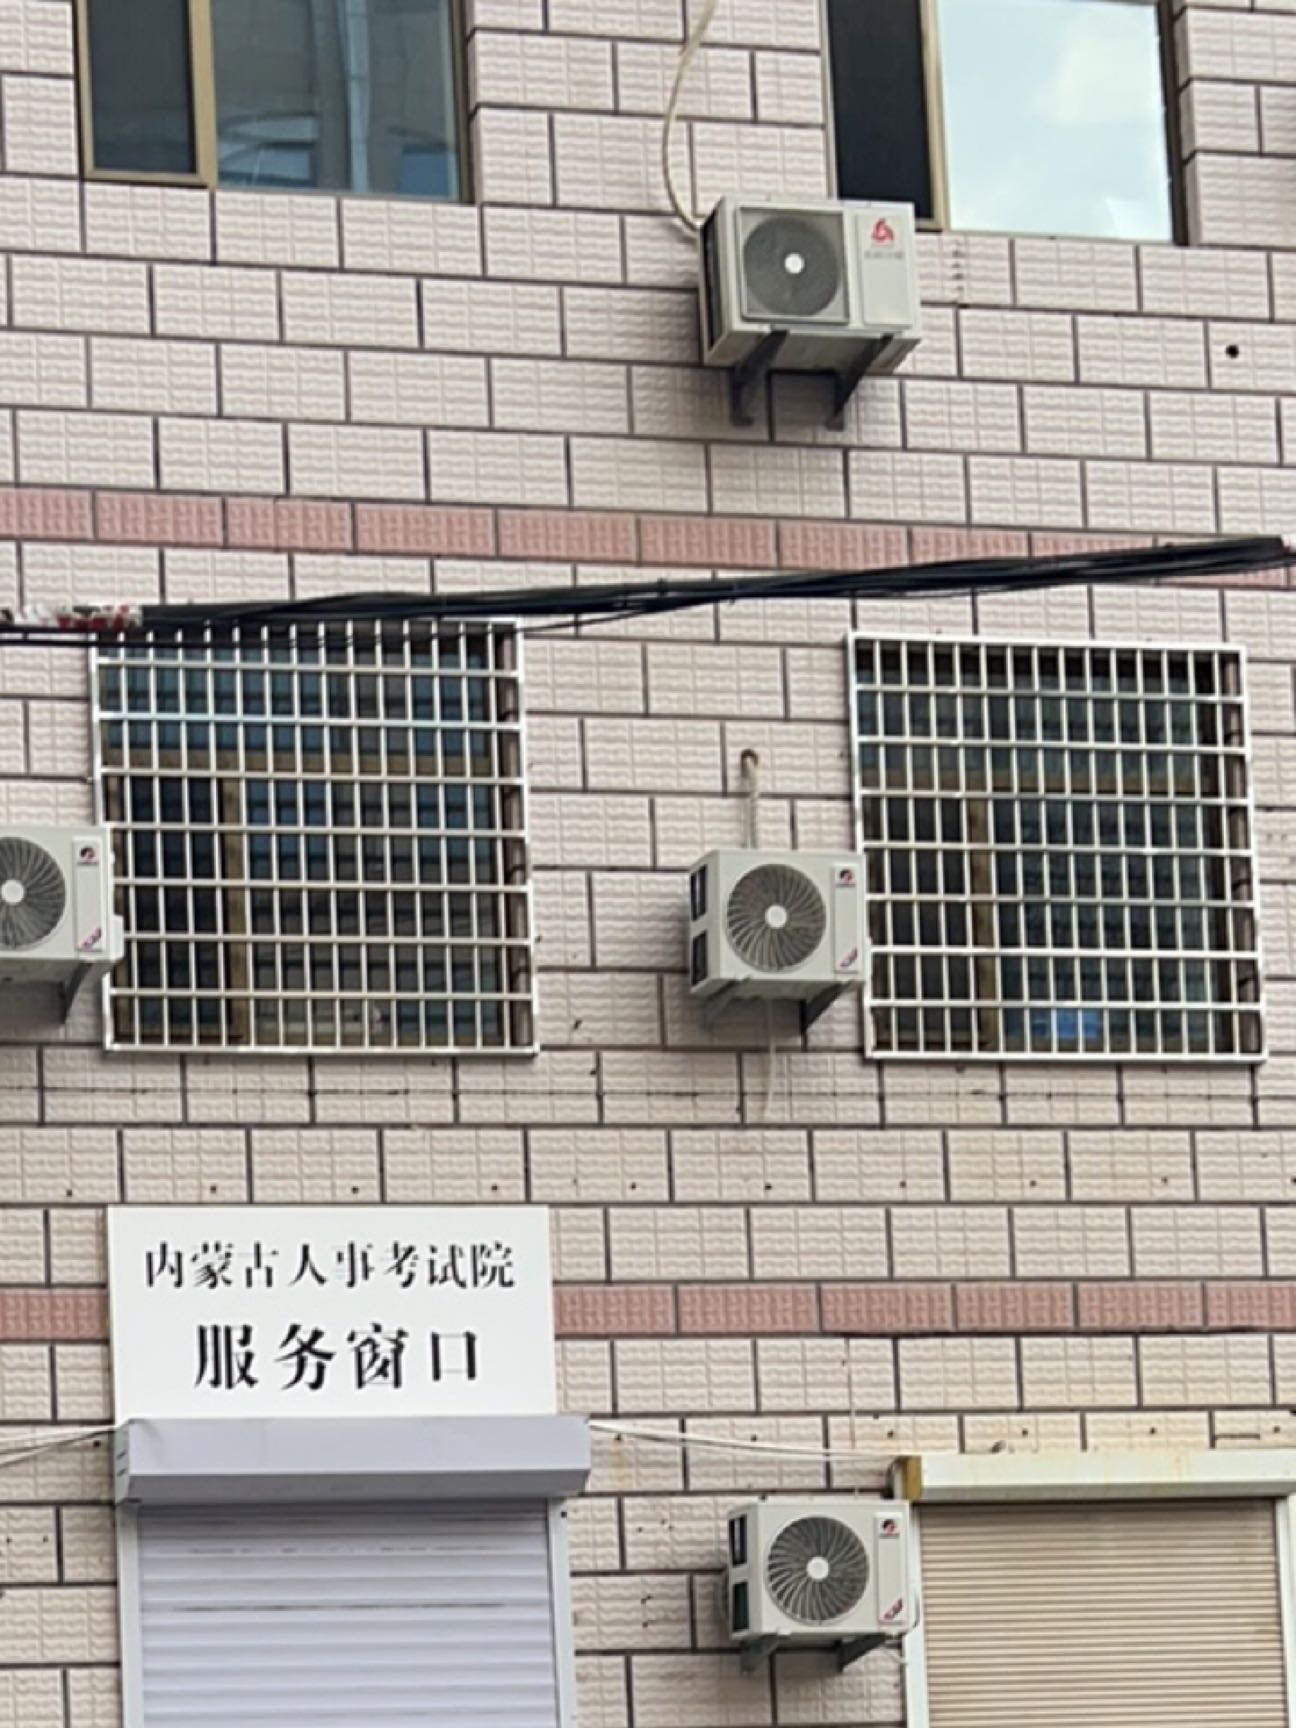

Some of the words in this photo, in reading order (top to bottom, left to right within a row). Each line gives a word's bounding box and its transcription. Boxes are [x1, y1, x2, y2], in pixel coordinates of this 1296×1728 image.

[145, 1240, 515, 1290] 内蒙古人事考试院
[194, 1322, 479, 1390] 服务窗口
